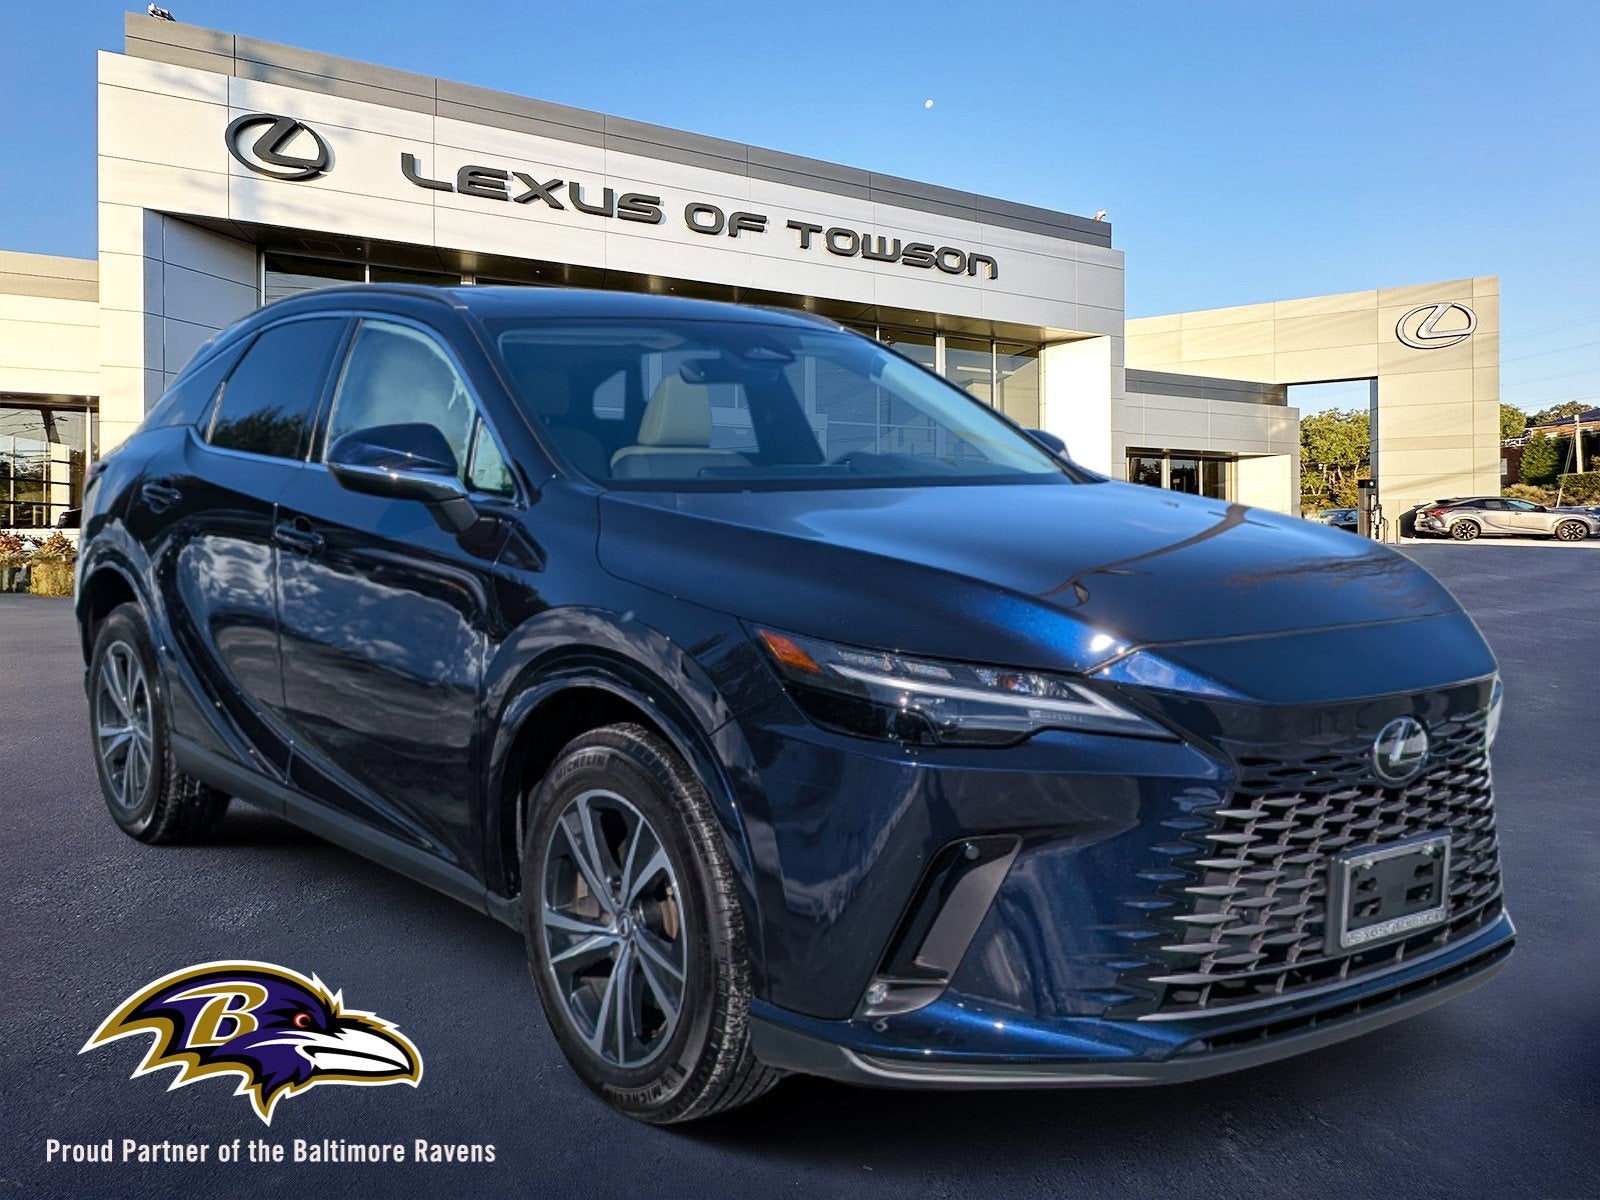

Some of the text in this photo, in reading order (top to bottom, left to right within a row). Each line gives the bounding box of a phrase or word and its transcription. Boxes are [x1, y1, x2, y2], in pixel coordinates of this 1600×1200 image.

[400, 152, 999, 280] LEXUS OF TOWSON
